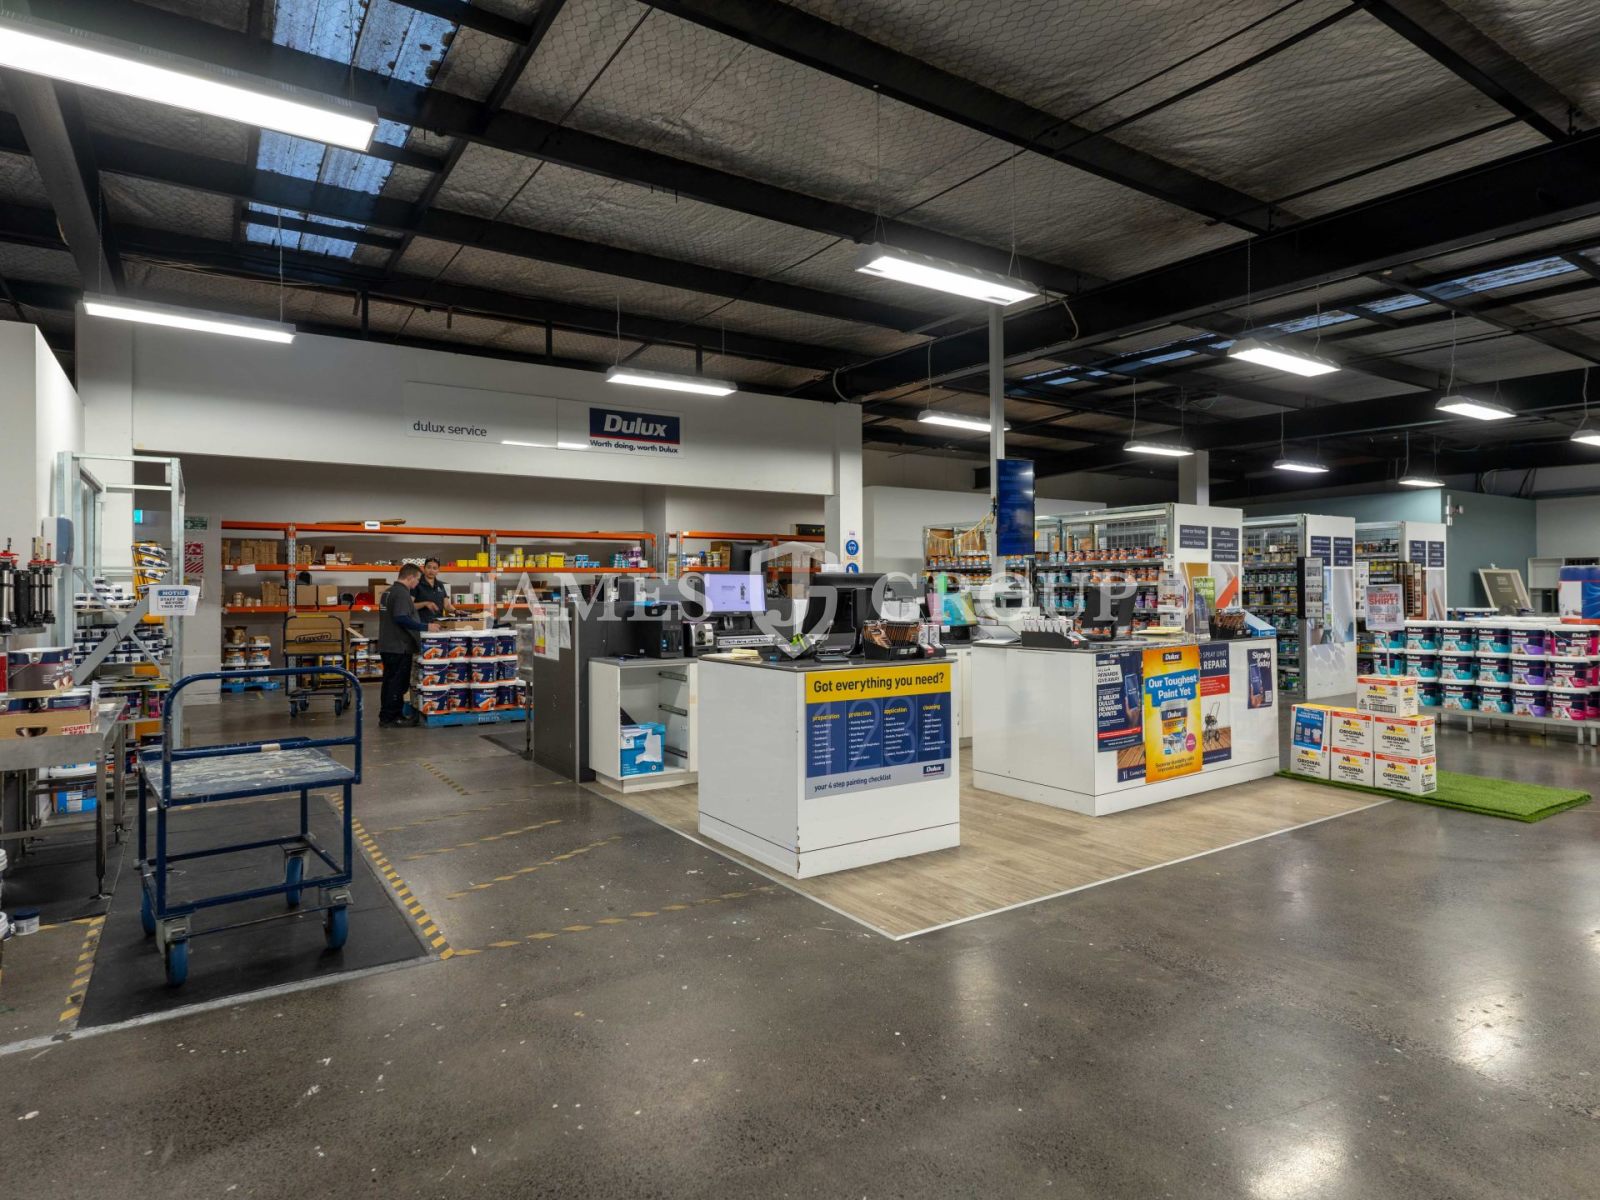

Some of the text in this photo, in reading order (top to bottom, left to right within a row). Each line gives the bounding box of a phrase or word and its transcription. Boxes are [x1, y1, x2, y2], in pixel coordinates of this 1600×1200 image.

[413, 420, 487, 437] dulux service
[604, 414, 668, 437] Dulux
[590, 440, 612, 448] Worth
[614, 442, 636, 451] doing,
[1204, 659, 1227, 669] REPAIR
[814, 672, 945, 692] Got everything you need?
[1148, 679, 1163, 688] Our
[1163, 674, 1197, 686] Toughest
[1158, 687, 1191, 699] Paint Yet
[1339, 729, 1364, 737] ORIGINAL
[1382, 735, 1410, 743] ORIGINAL
[1297, 758, 1320, 766] ORIGINAL
[1338, 765, 1364, 774] ORIGINAL
[1383, 772, 1410, 781] ORIGINAL
[814, 783, 827, 792] your
[833, 781, 845, 789] step
[846, 777, 867, 787] painting
[868, 774, 892, 783] checklist
